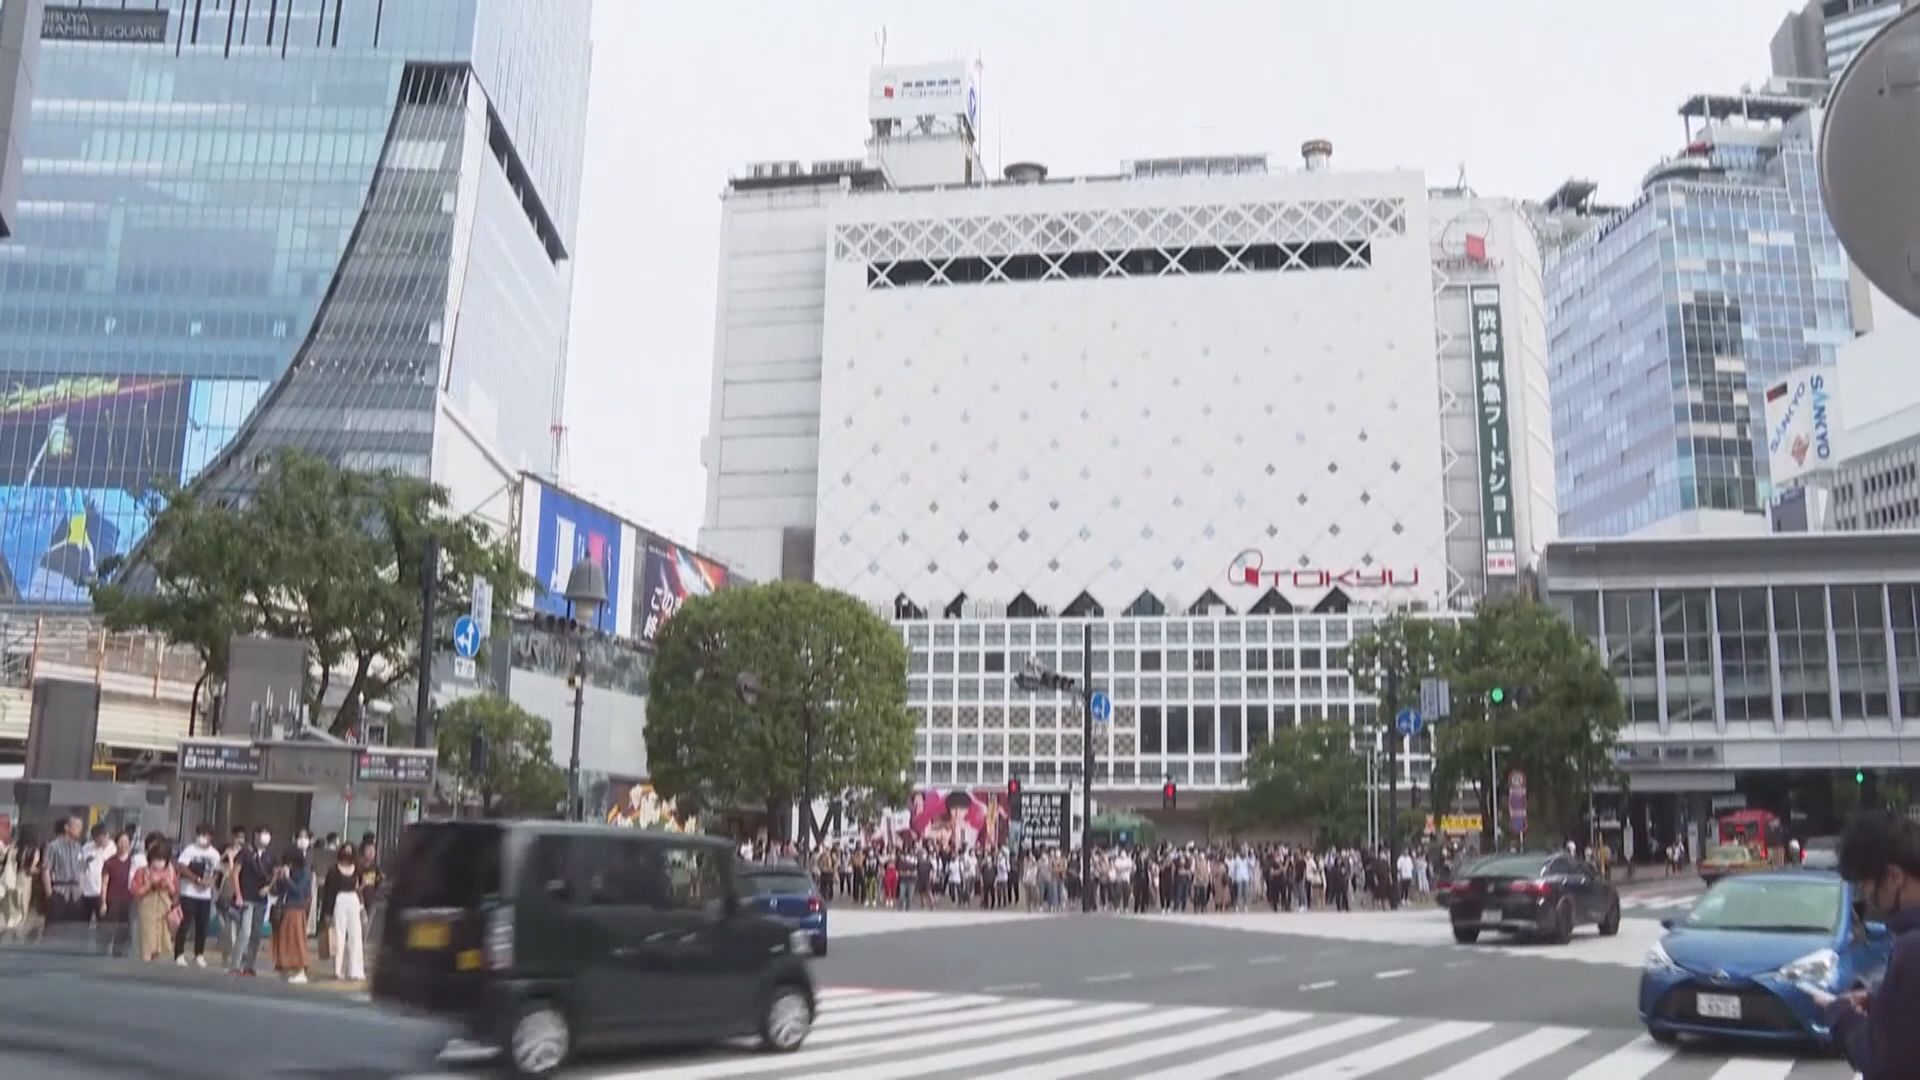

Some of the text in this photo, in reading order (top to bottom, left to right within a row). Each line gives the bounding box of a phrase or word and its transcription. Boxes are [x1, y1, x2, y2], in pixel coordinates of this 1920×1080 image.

[103, 25, 161, 39] SQUARE
[1770, 383, 1805, 455] SANKYO
[1811, 375, 1830, 459] SANKYO
[1260, 566, 1419, 588] TOKYU
